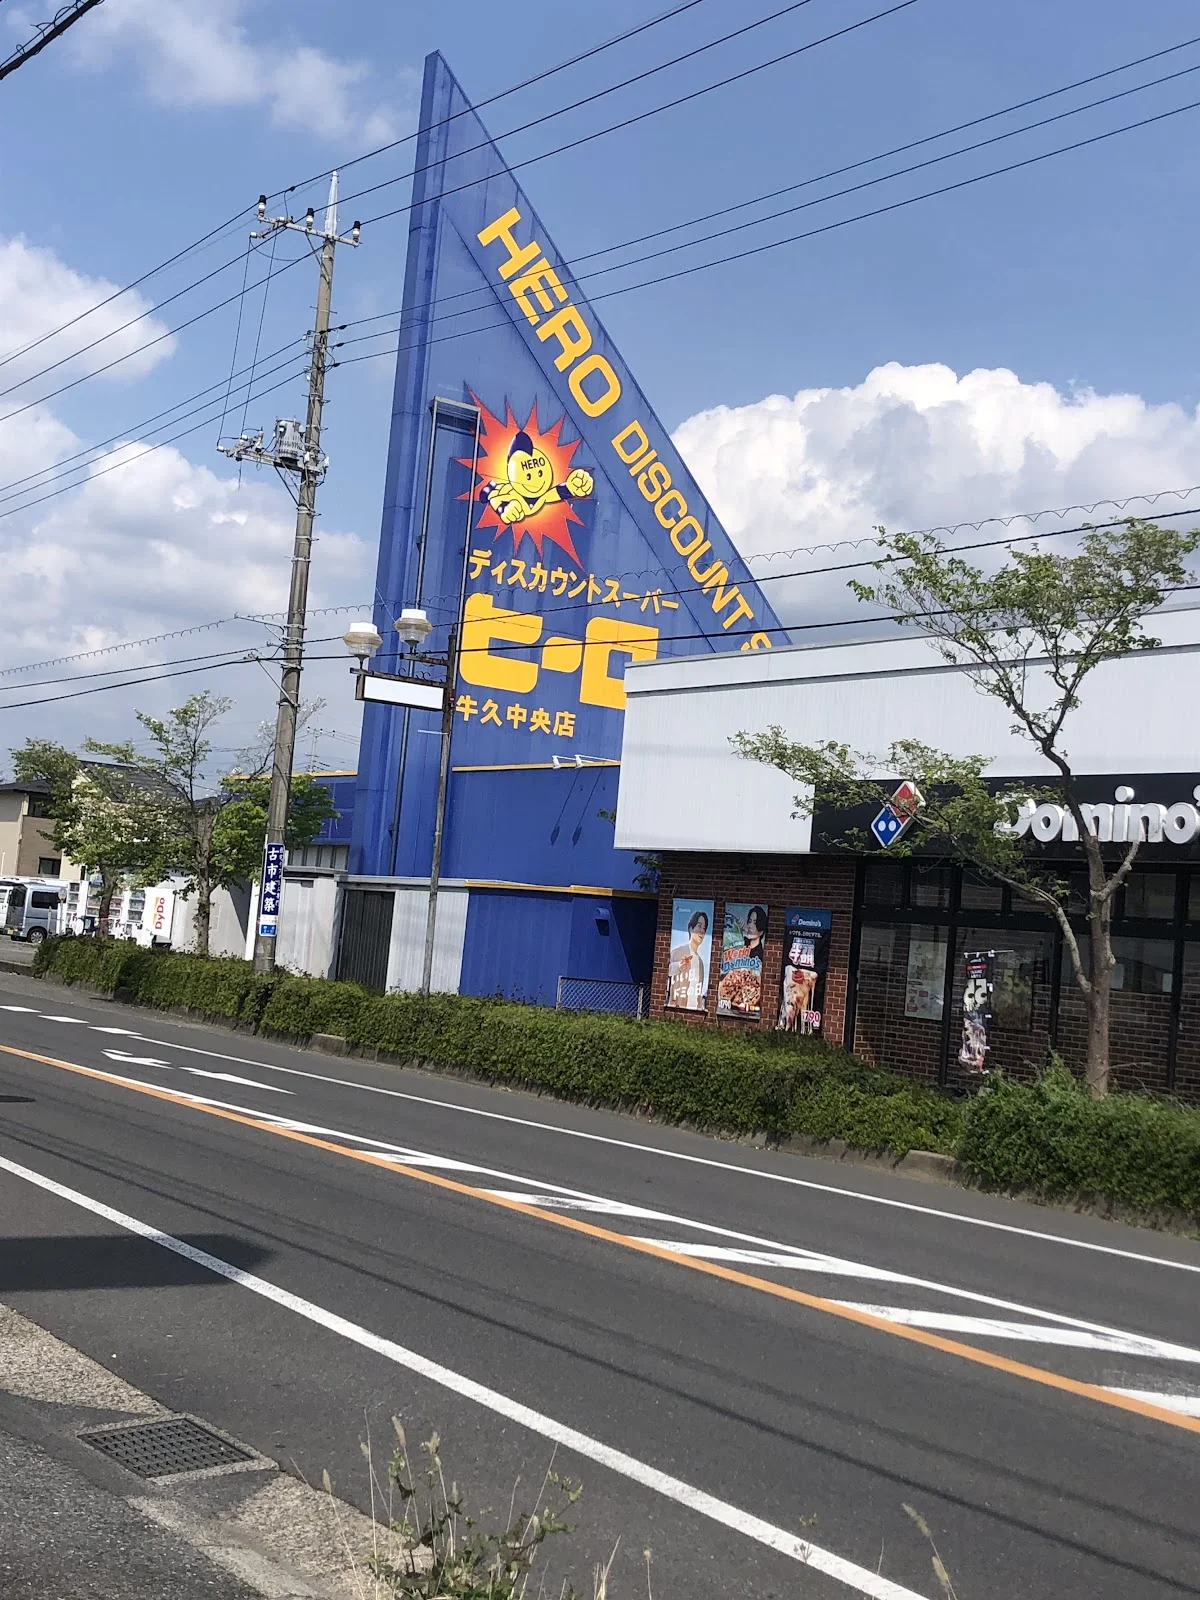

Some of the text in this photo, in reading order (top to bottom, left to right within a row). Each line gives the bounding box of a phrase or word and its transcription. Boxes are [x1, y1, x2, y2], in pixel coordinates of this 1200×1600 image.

[477, 207, 754, 630] HERO DISCOUNT
[520, 457, 546, 471] HERO
[469, 549, 679, 614] ディスカウントスーパー
[456, 695, 577, 737] 牛久中央店
[263, 847, 279, 912] 古市建築
[155, 897, 165, 930] DyDo
